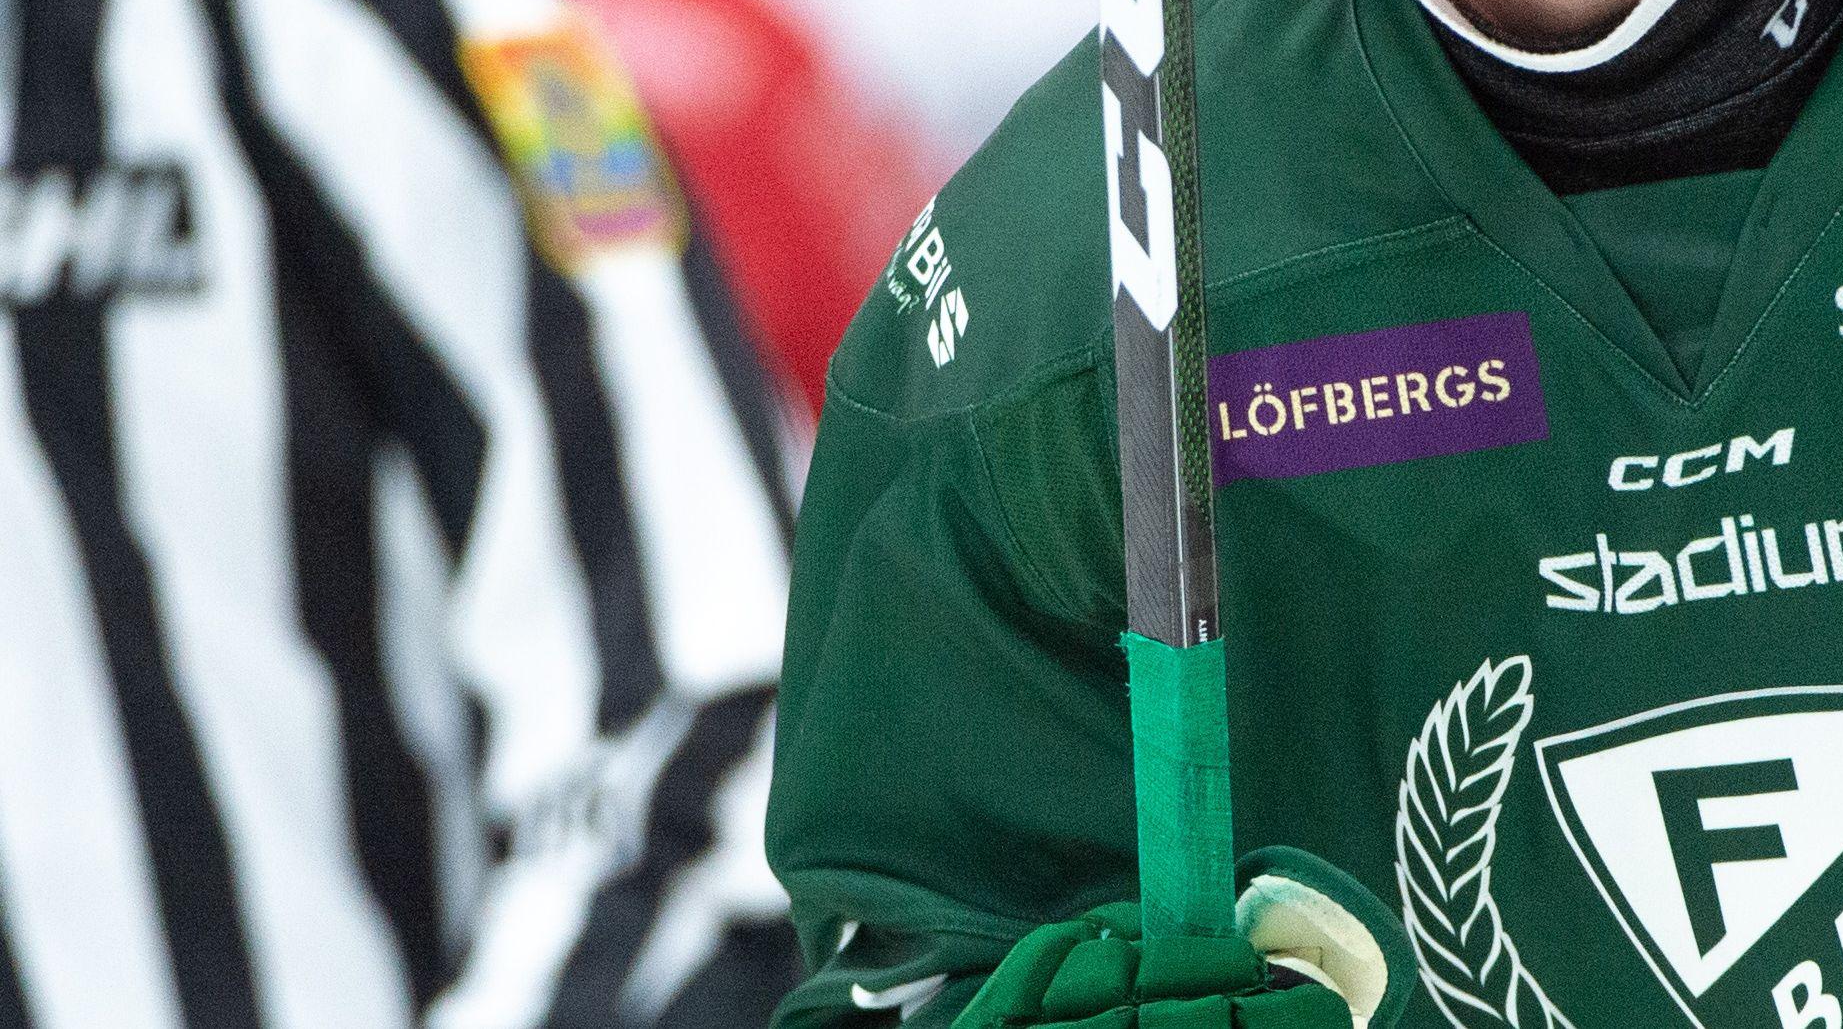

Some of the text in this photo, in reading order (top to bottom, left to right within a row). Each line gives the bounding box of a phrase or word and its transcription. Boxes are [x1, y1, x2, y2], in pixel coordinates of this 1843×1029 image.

[906, 226, 952, 311] Bil
[1218, 358, 1512, 442] LÖFBERGS
[1607, 427, 1796, 492] CCM
[1651, 757, 1800, 960] F
